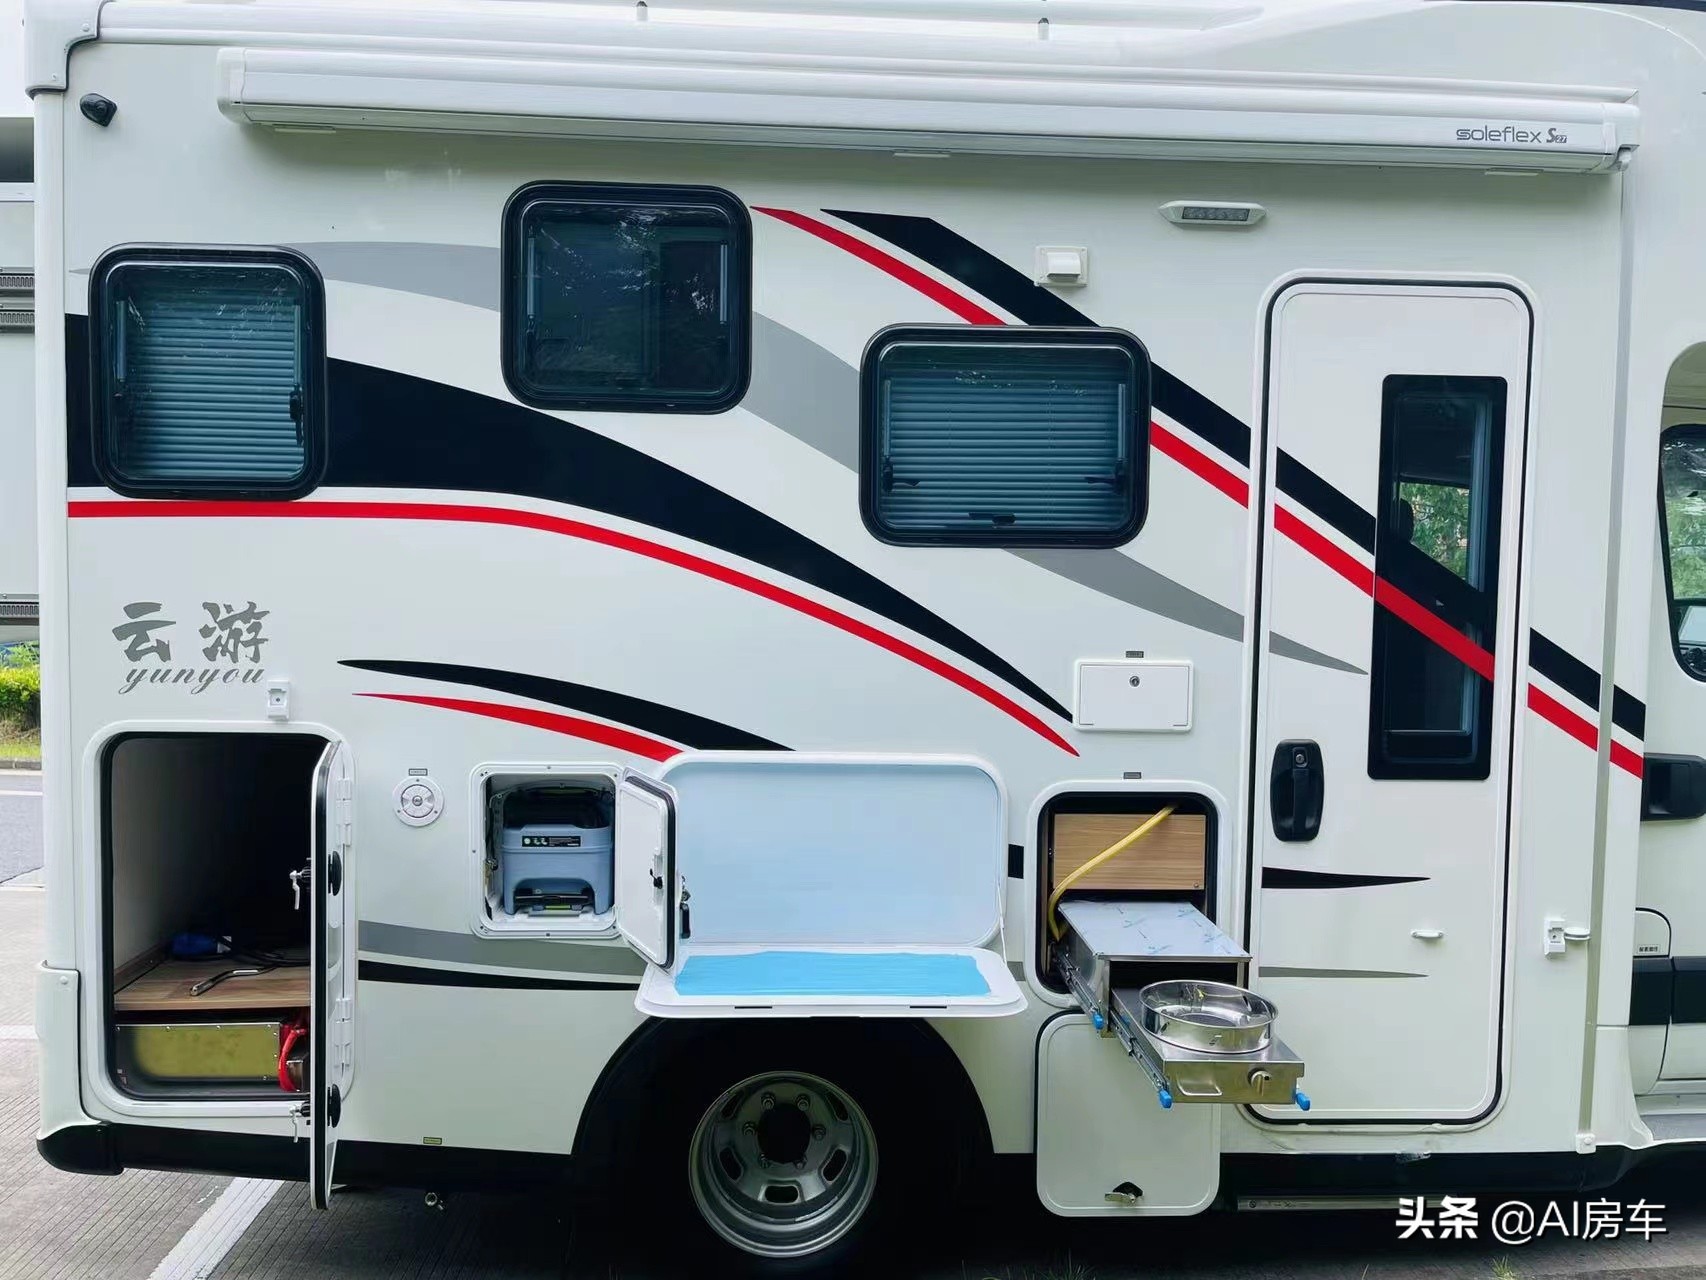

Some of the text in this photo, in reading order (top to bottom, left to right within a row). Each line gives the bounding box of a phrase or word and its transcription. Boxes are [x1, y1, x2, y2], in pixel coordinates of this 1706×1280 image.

[1456, 125, 1541, 143] soleflex
[112, 601, 270, 664] 云游
[118, 667, 265, 695] yunyou
